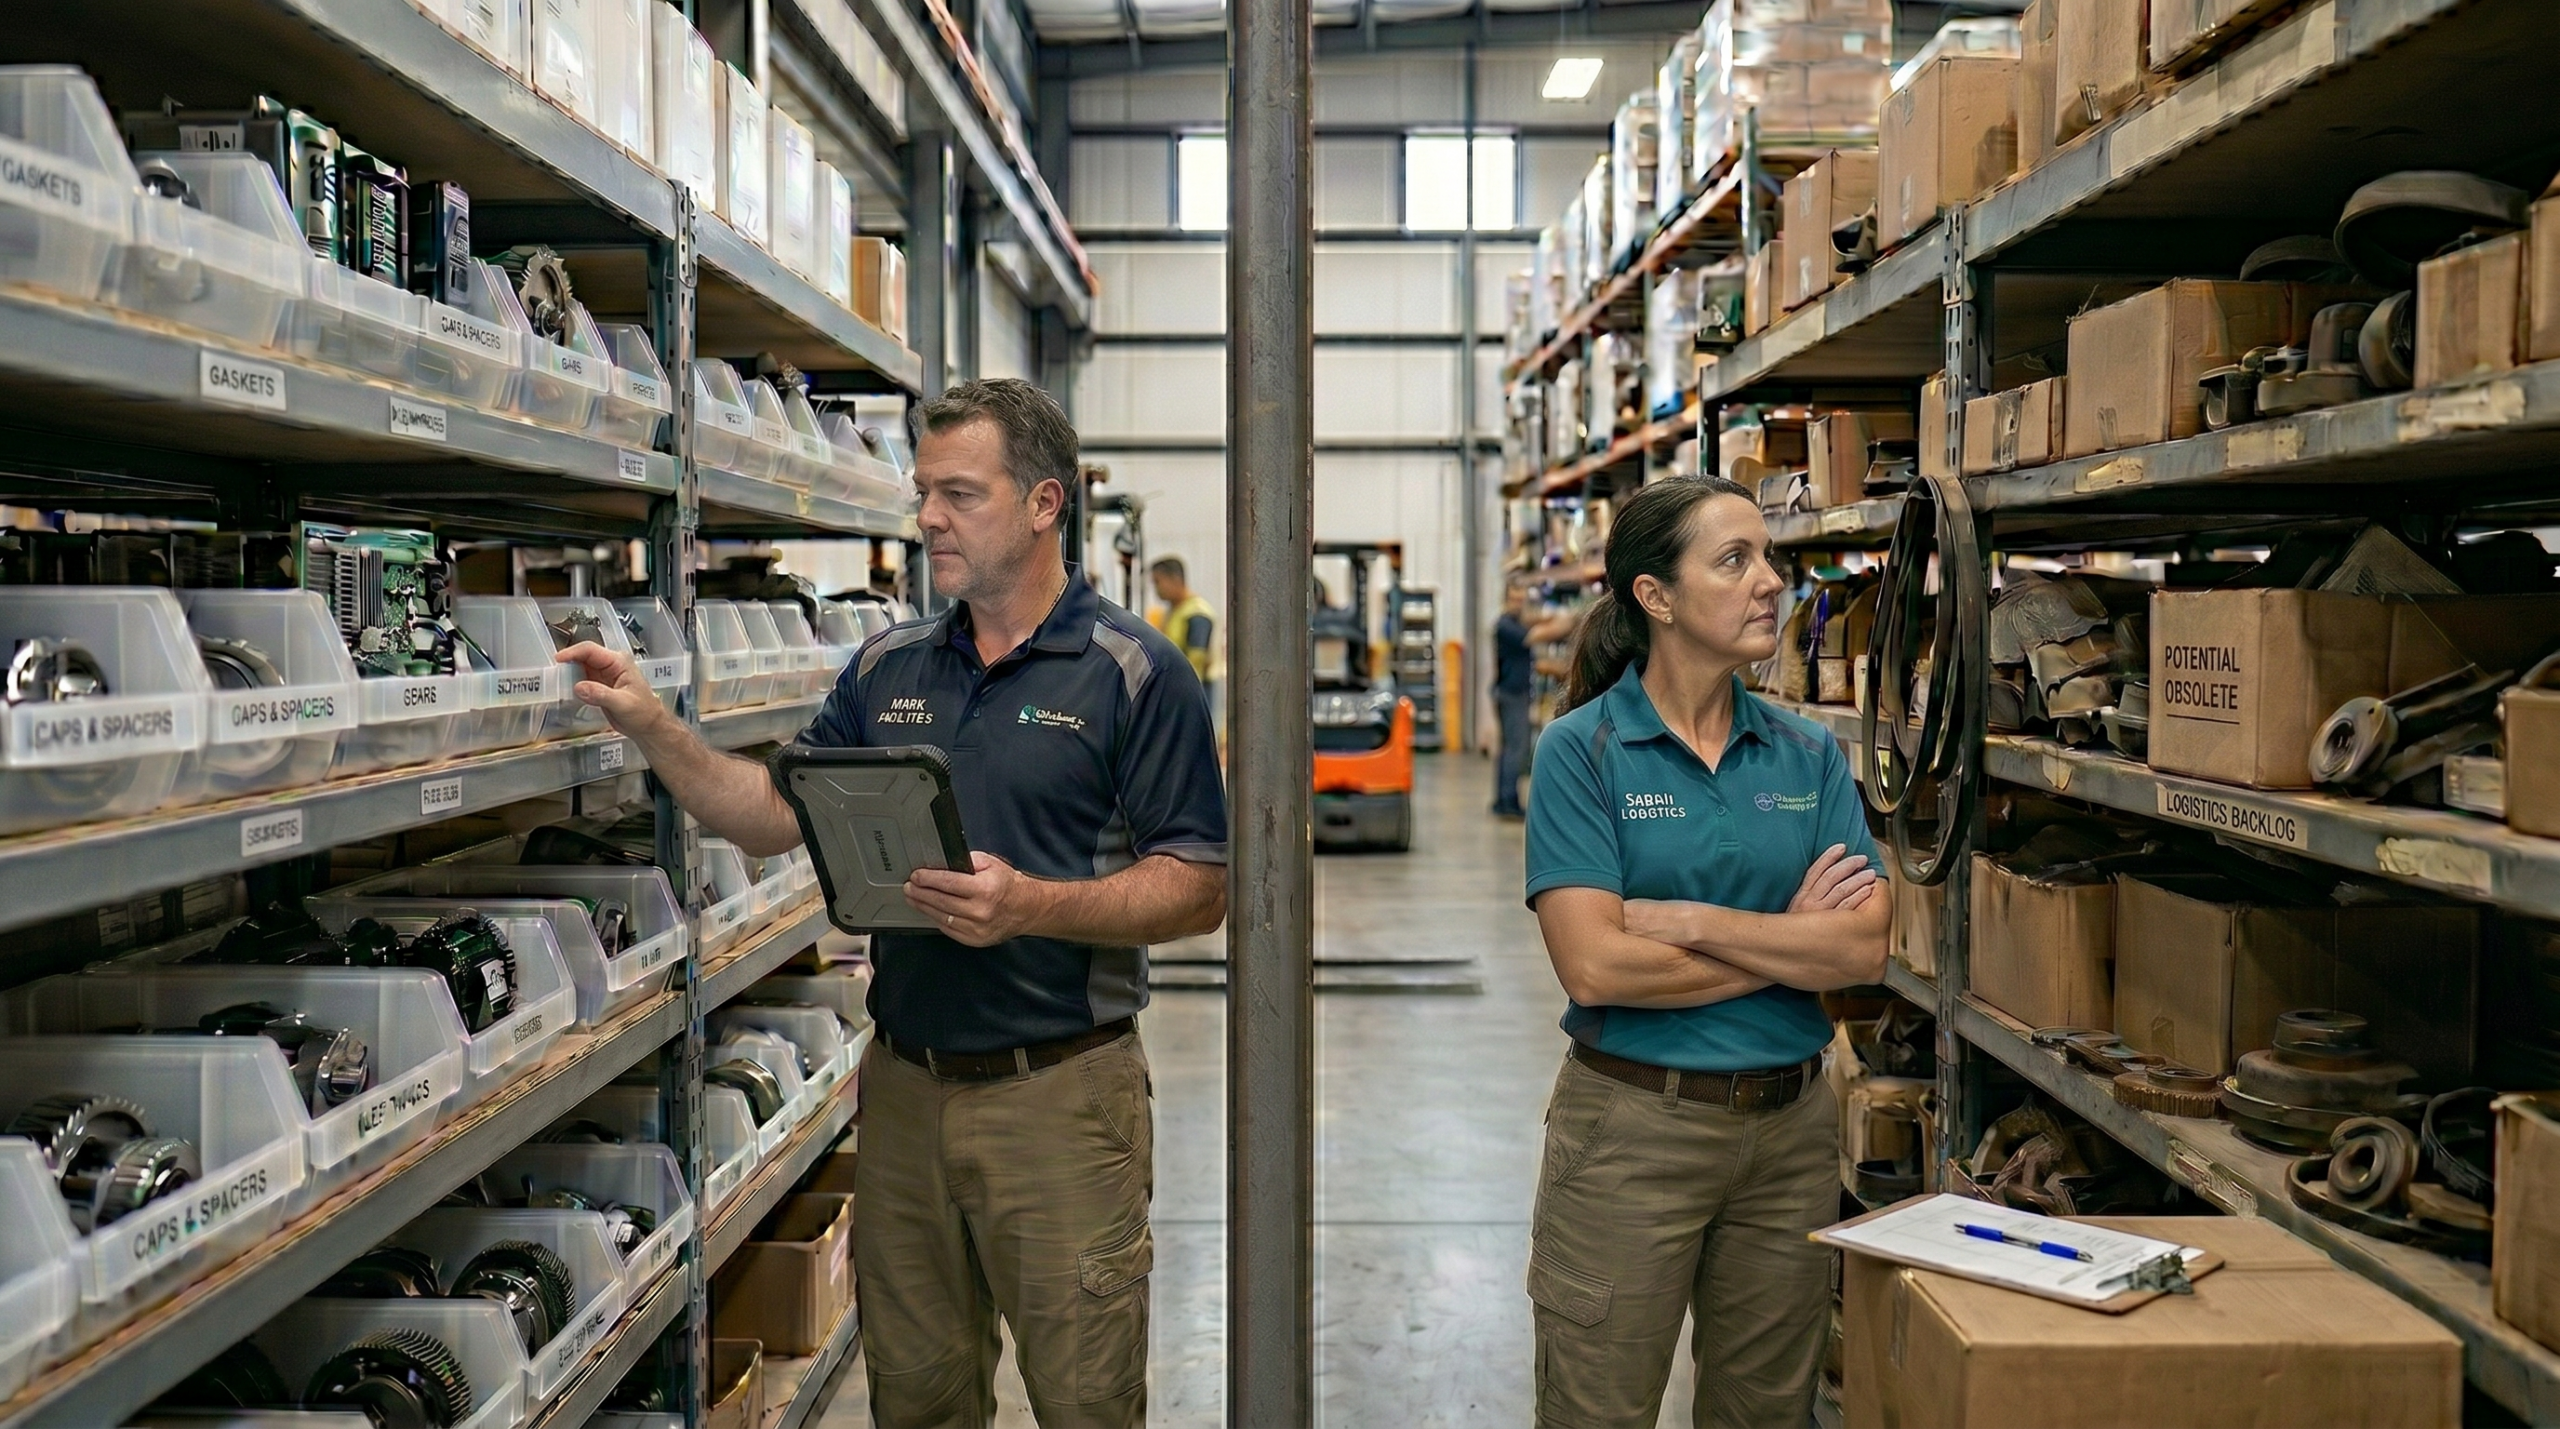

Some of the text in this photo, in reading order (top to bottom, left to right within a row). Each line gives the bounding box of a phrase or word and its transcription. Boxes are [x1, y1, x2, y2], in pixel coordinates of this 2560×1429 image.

[2, 157, 82, 207] GASKETS
[209, 364, 276, 398] GASKETS
[2165, 645, 2240, 673] POTENTIAL
[270, 701, 278, 722] &
[281, 696, 334, 721] SPACERS
[890, 698, 926, 711] MARK
[2165, 680, 2238, 710] OBSOLETE
[102, 710, 173, 740] SPACERS
[2166, 791, 2296, 843] LOGISTICS BACKLOG
[132, 1217, 179, 1259] CAPS
[200, 1168, 267, 1225] SPACERS
